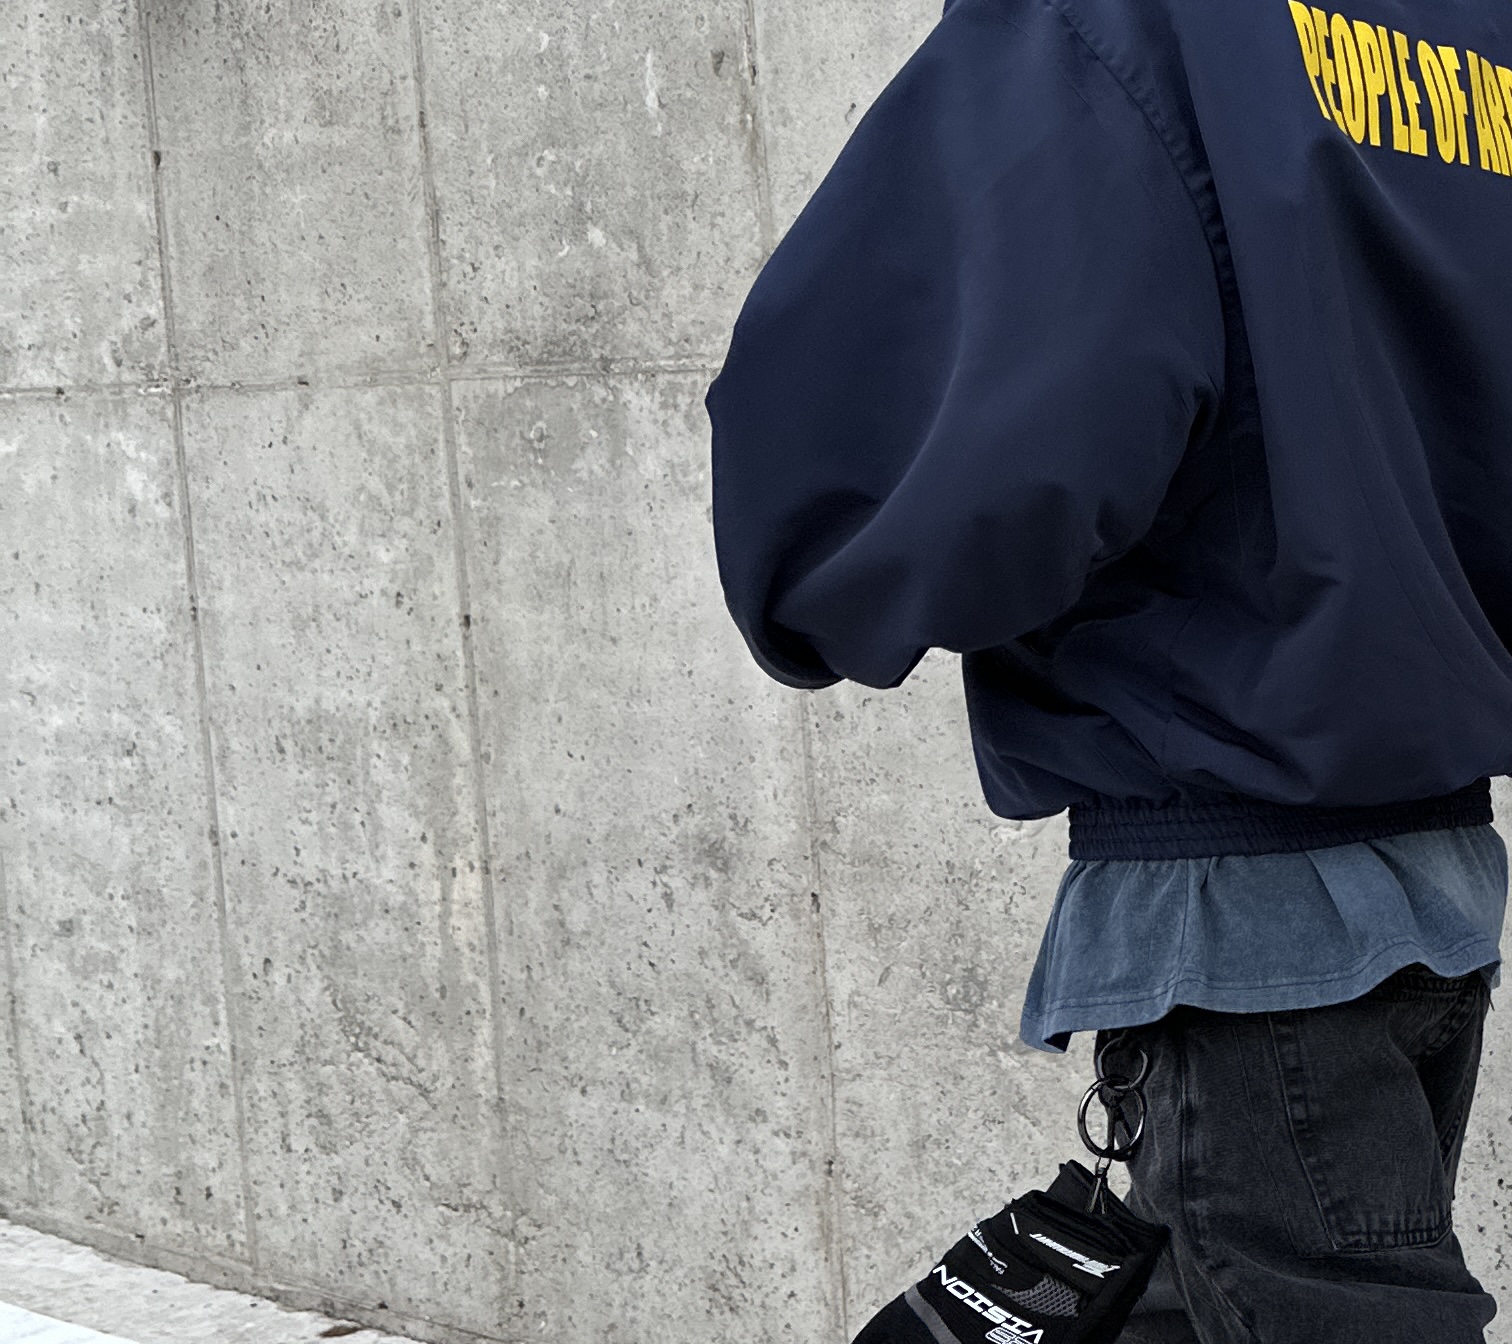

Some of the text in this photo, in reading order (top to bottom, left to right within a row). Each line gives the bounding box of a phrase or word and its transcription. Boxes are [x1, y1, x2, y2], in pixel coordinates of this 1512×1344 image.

[1287, 0, 1429, 157] PEOPLE
[1416, 40, 1470, 166] OF
[933, 1264, 1044, 1344] VISION
